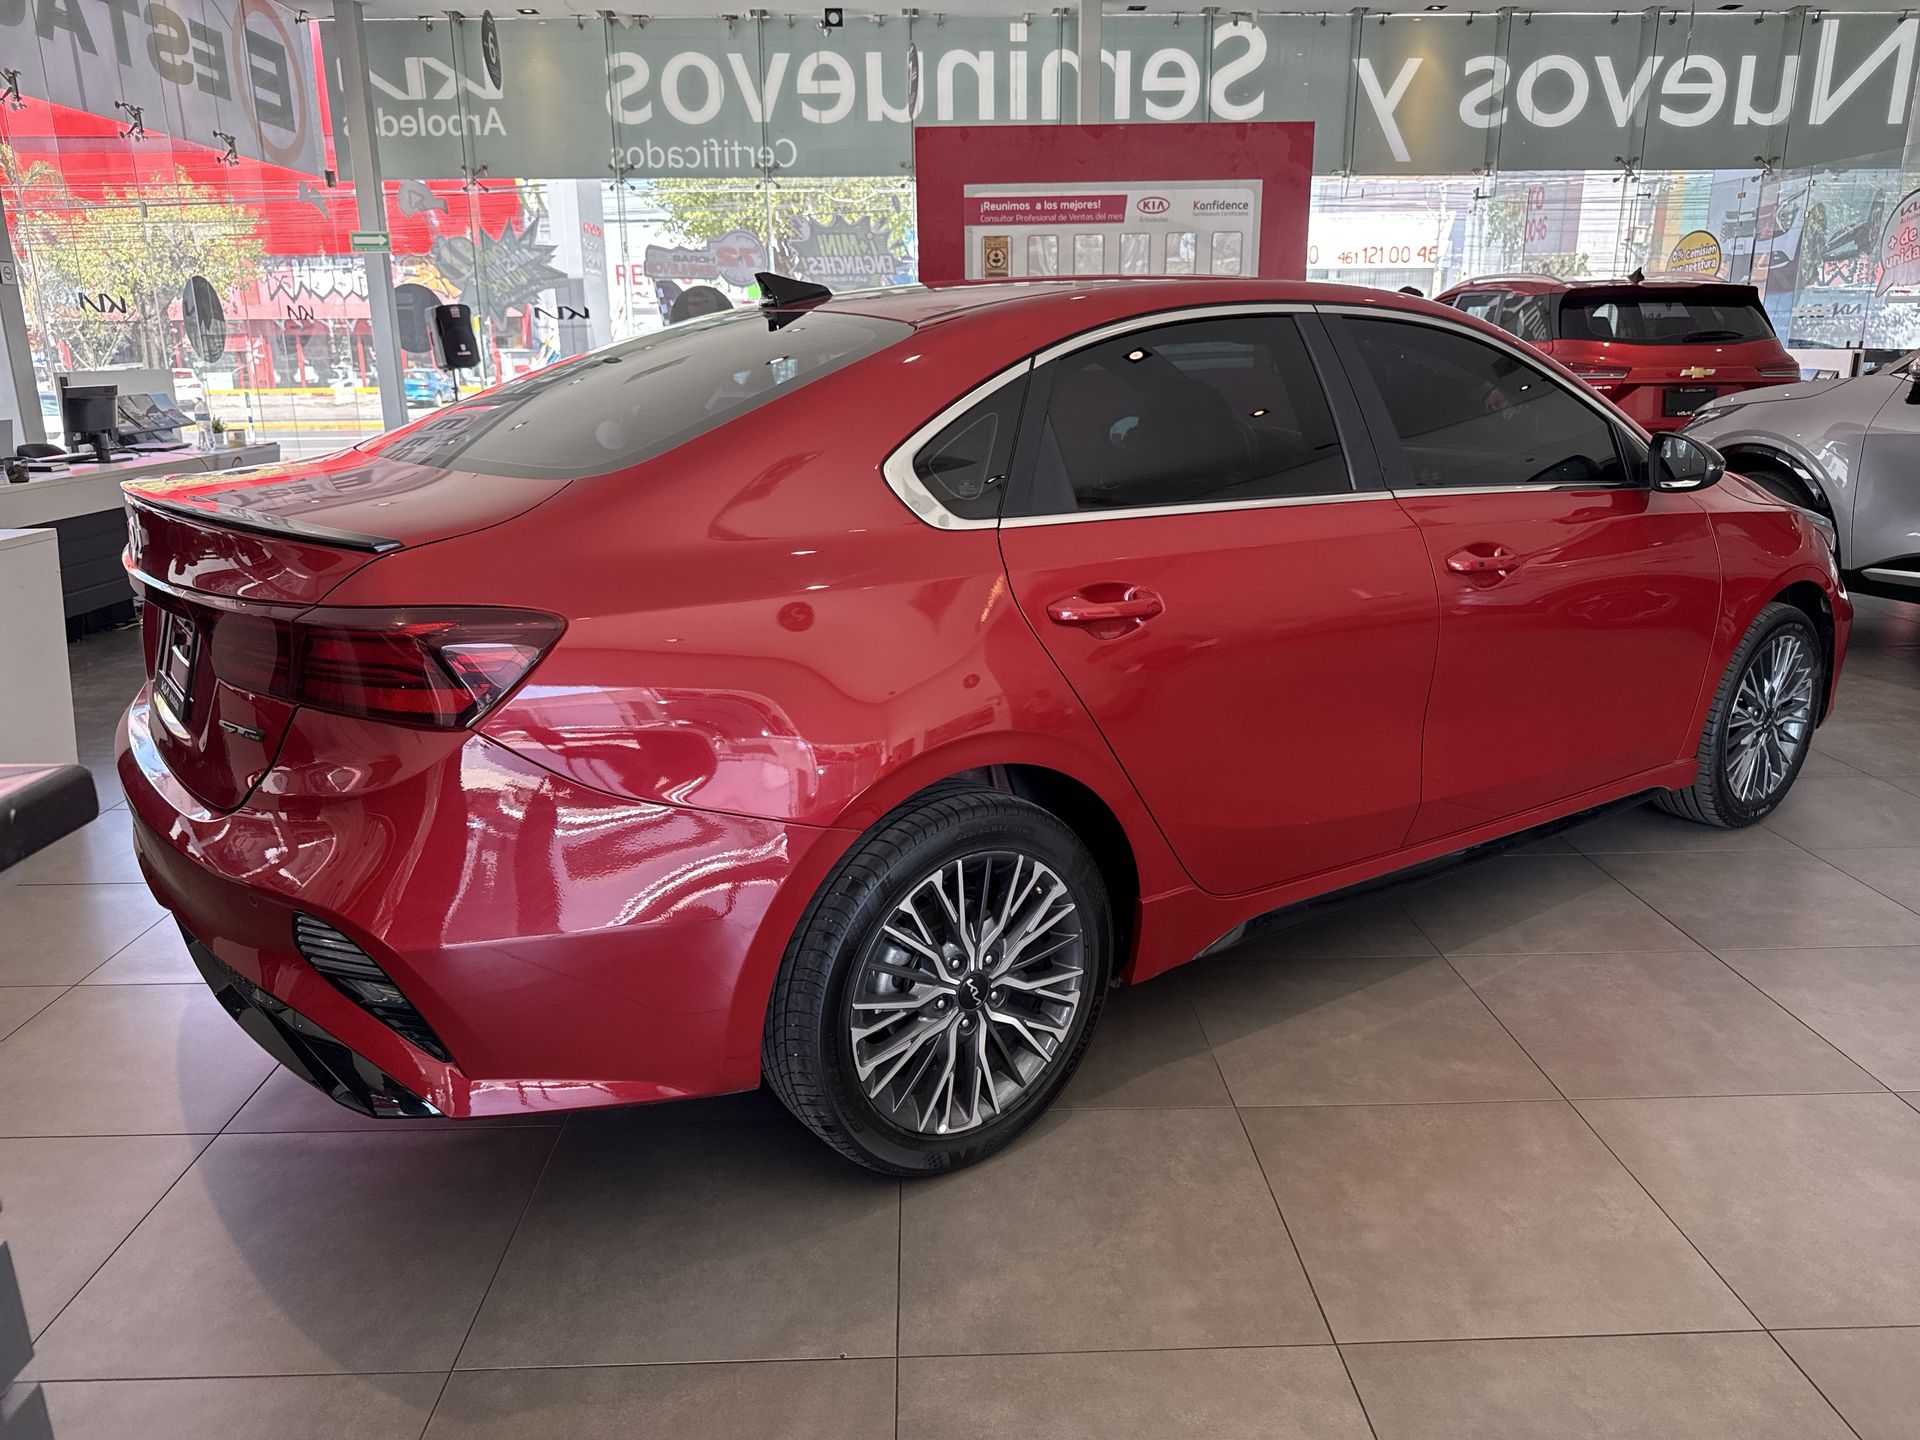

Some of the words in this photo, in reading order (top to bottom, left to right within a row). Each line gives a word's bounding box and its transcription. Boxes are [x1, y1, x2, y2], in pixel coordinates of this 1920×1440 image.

[980, 201, 1031, 213] ¡Reunimos
[1043, 201, 1058, 210] los
[1060, 199, 1101, 212] mejores!
[1143, 201, 1166, 210] KIA
[1193, 200, 1249, 211] Konfidence
[980, 214, 1014, 223] Consultor
[1015, 214, 1057, 222] Profesional
[1069, 213, 1094, 221] Ventas
[1095, 212, 1107, 220] del
